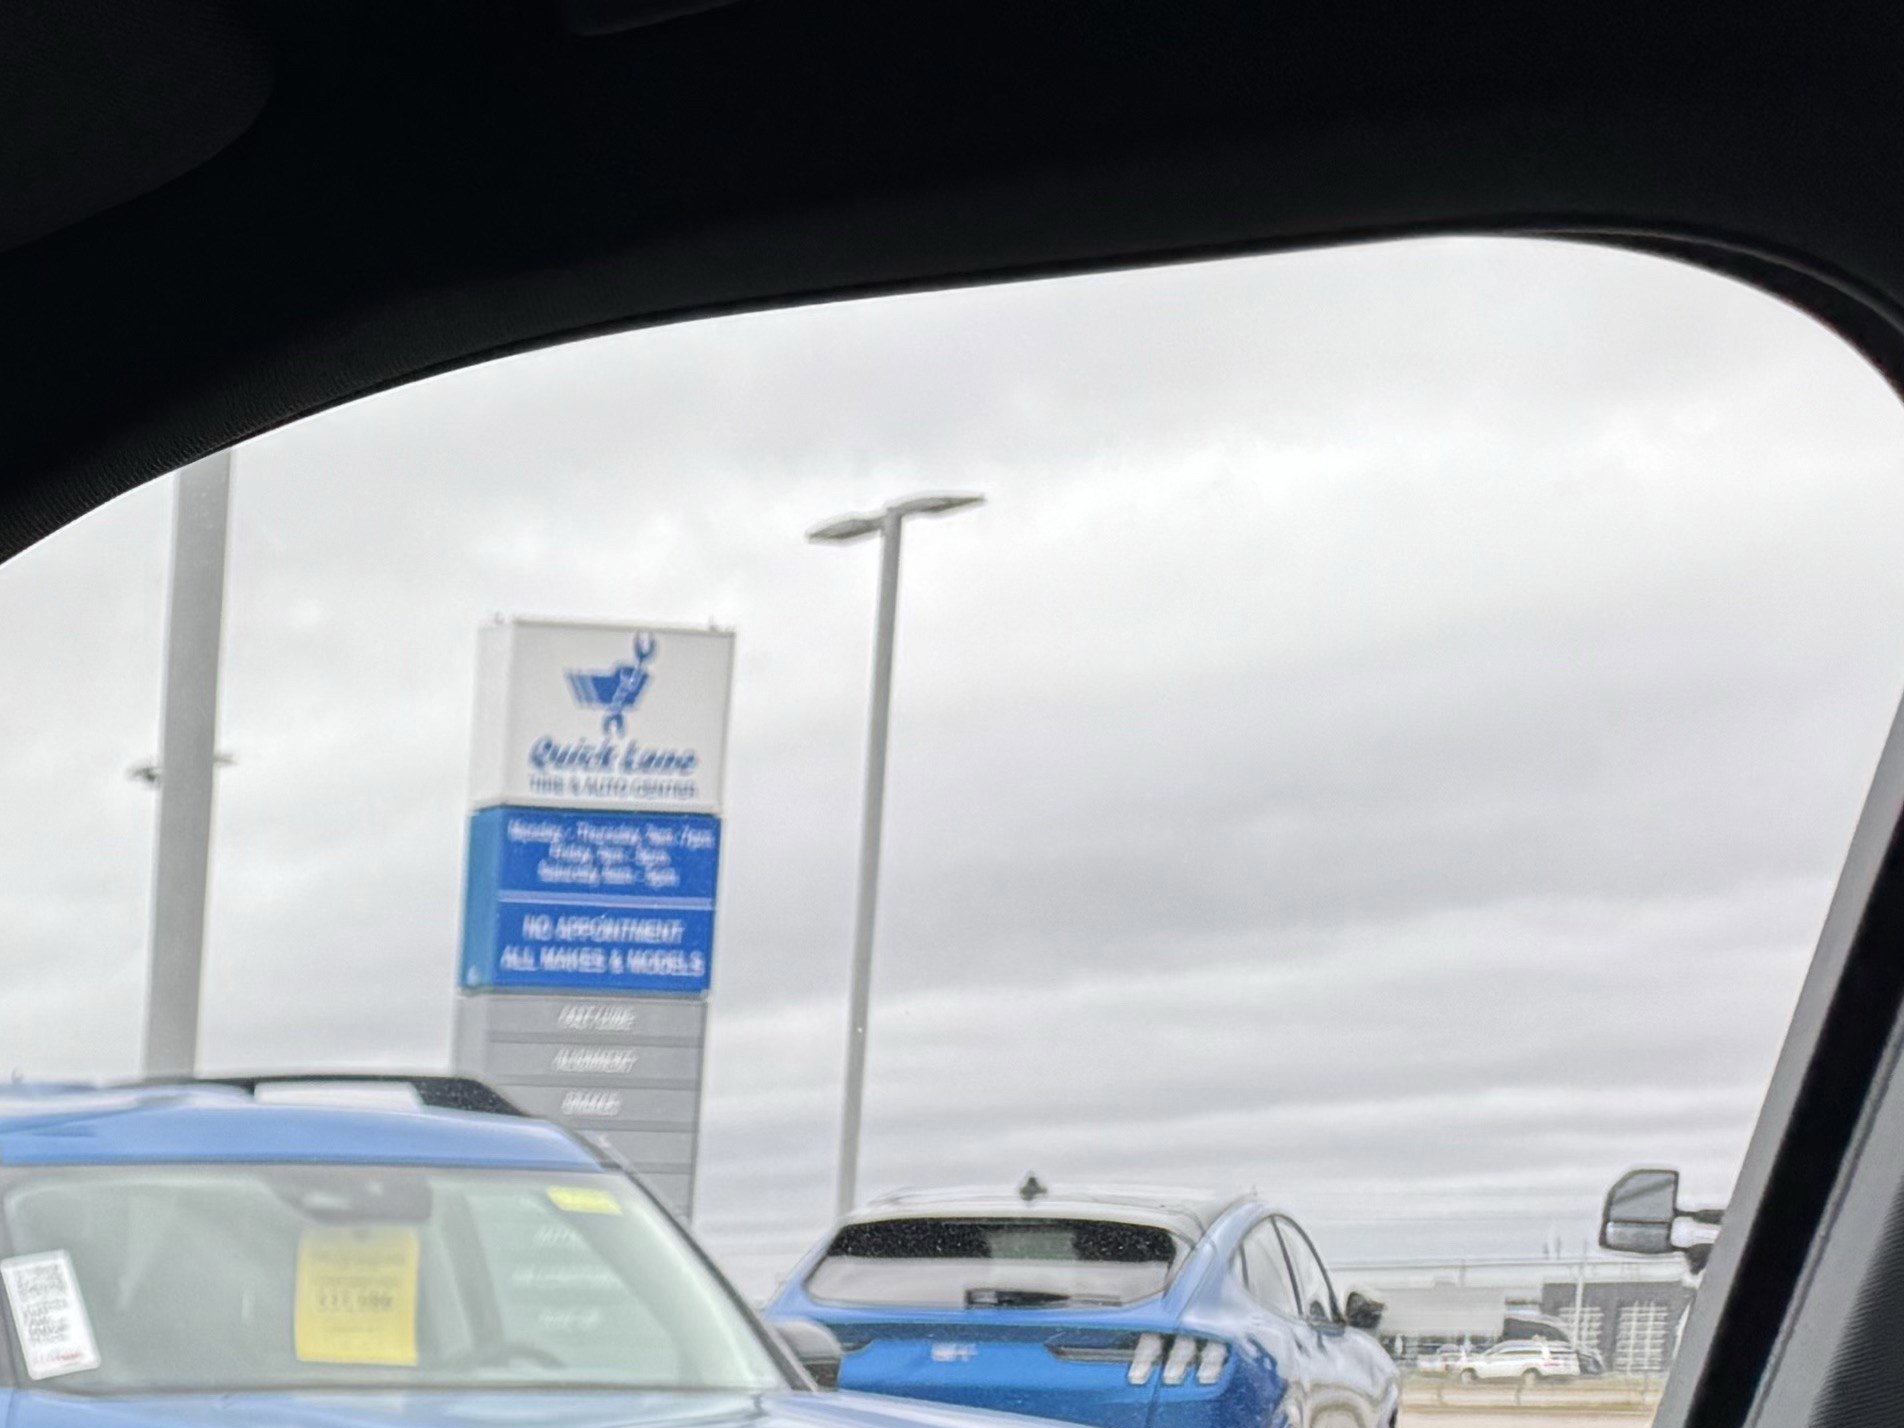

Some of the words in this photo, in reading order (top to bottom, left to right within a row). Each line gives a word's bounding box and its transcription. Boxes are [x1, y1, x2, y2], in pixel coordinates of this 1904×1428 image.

[528, 734, 616, 771] Quick
[620, 738, 697, 773] Lane
[522, 914, 553, 940] NO
[555, 915, 686, 944] APPOINTMENT
[500, 946, 537, 971] ALL
[540, 946, 606, 974] MAKES
[609, 949, 624, 974] &
[627, 948, 705, 977] MODELS
